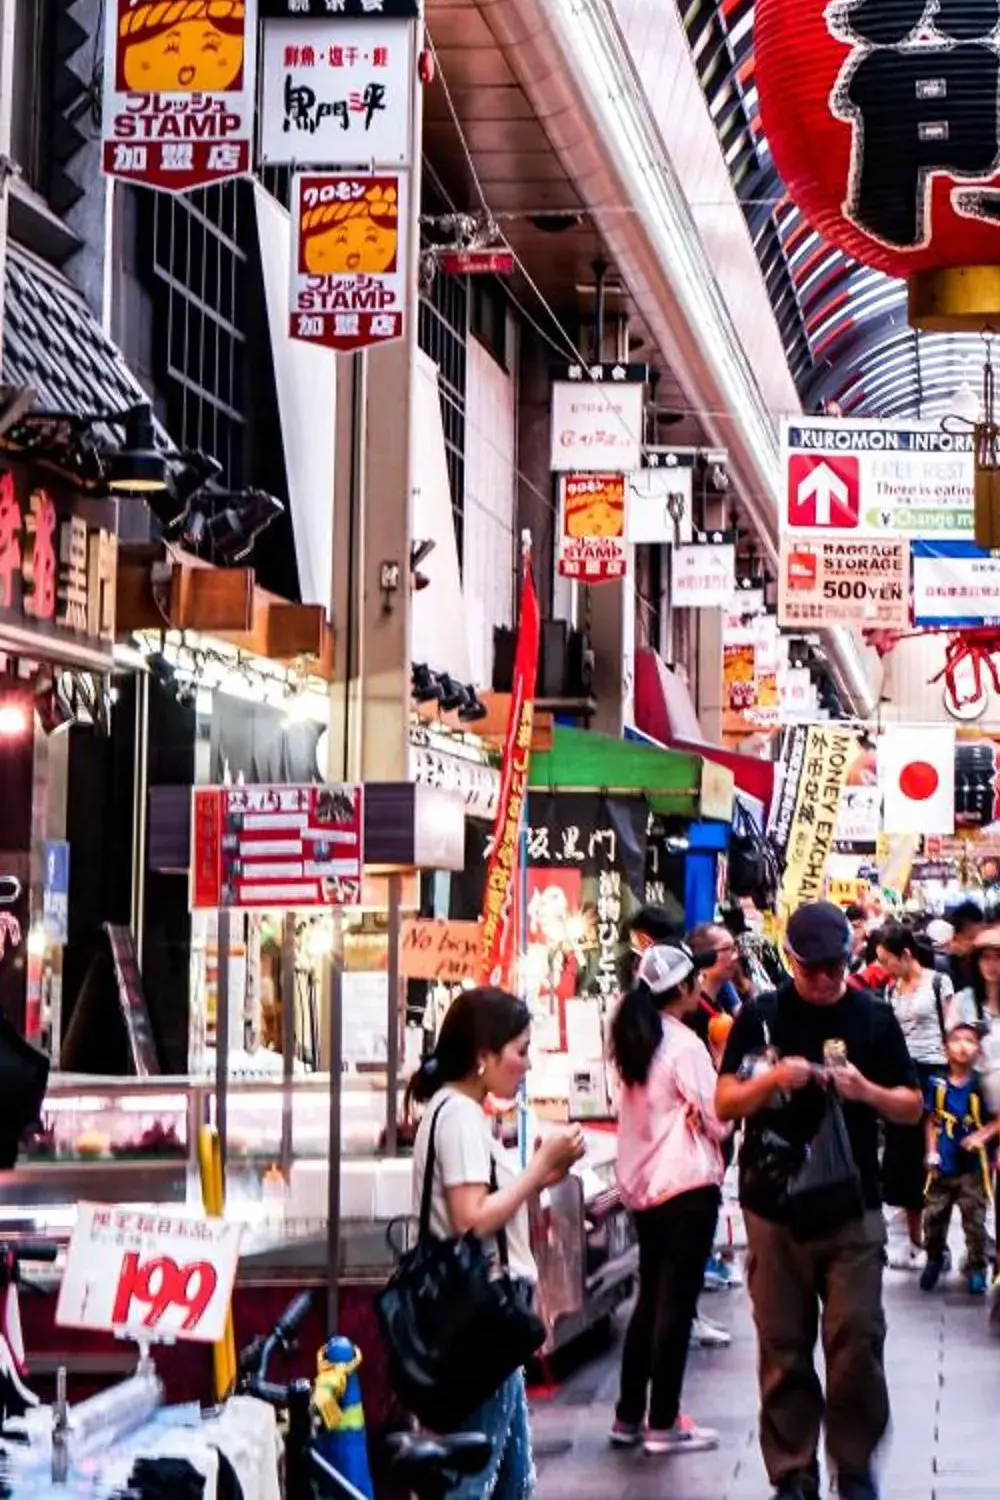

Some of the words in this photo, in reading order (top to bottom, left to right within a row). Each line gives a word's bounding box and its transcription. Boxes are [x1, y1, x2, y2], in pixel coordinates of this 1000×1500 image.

[125, 91, 227, 113] フレッシュ
[113, 114, 242, 138] STAMP
[112, 143, 242, 172] 加盟店
[303, 181, 366, 208] クロモン
[297, 290, 397, 310] STAMP
[800, 429, 899, 450] KUROMON
[876, 481, 917, 496] There
[918, 481, 931, 496] is
[896, 509, 957, 529] Change
[563, 547, 623, 560] STAMP
[823, 543, 903, 557] BAGGAGE
[823, 558, 903, 571] STORAGE
[825, 733, 851, 815] MONEY
[402, 927, 433, 950] No
[111, 1250, 218, 1331] 199
